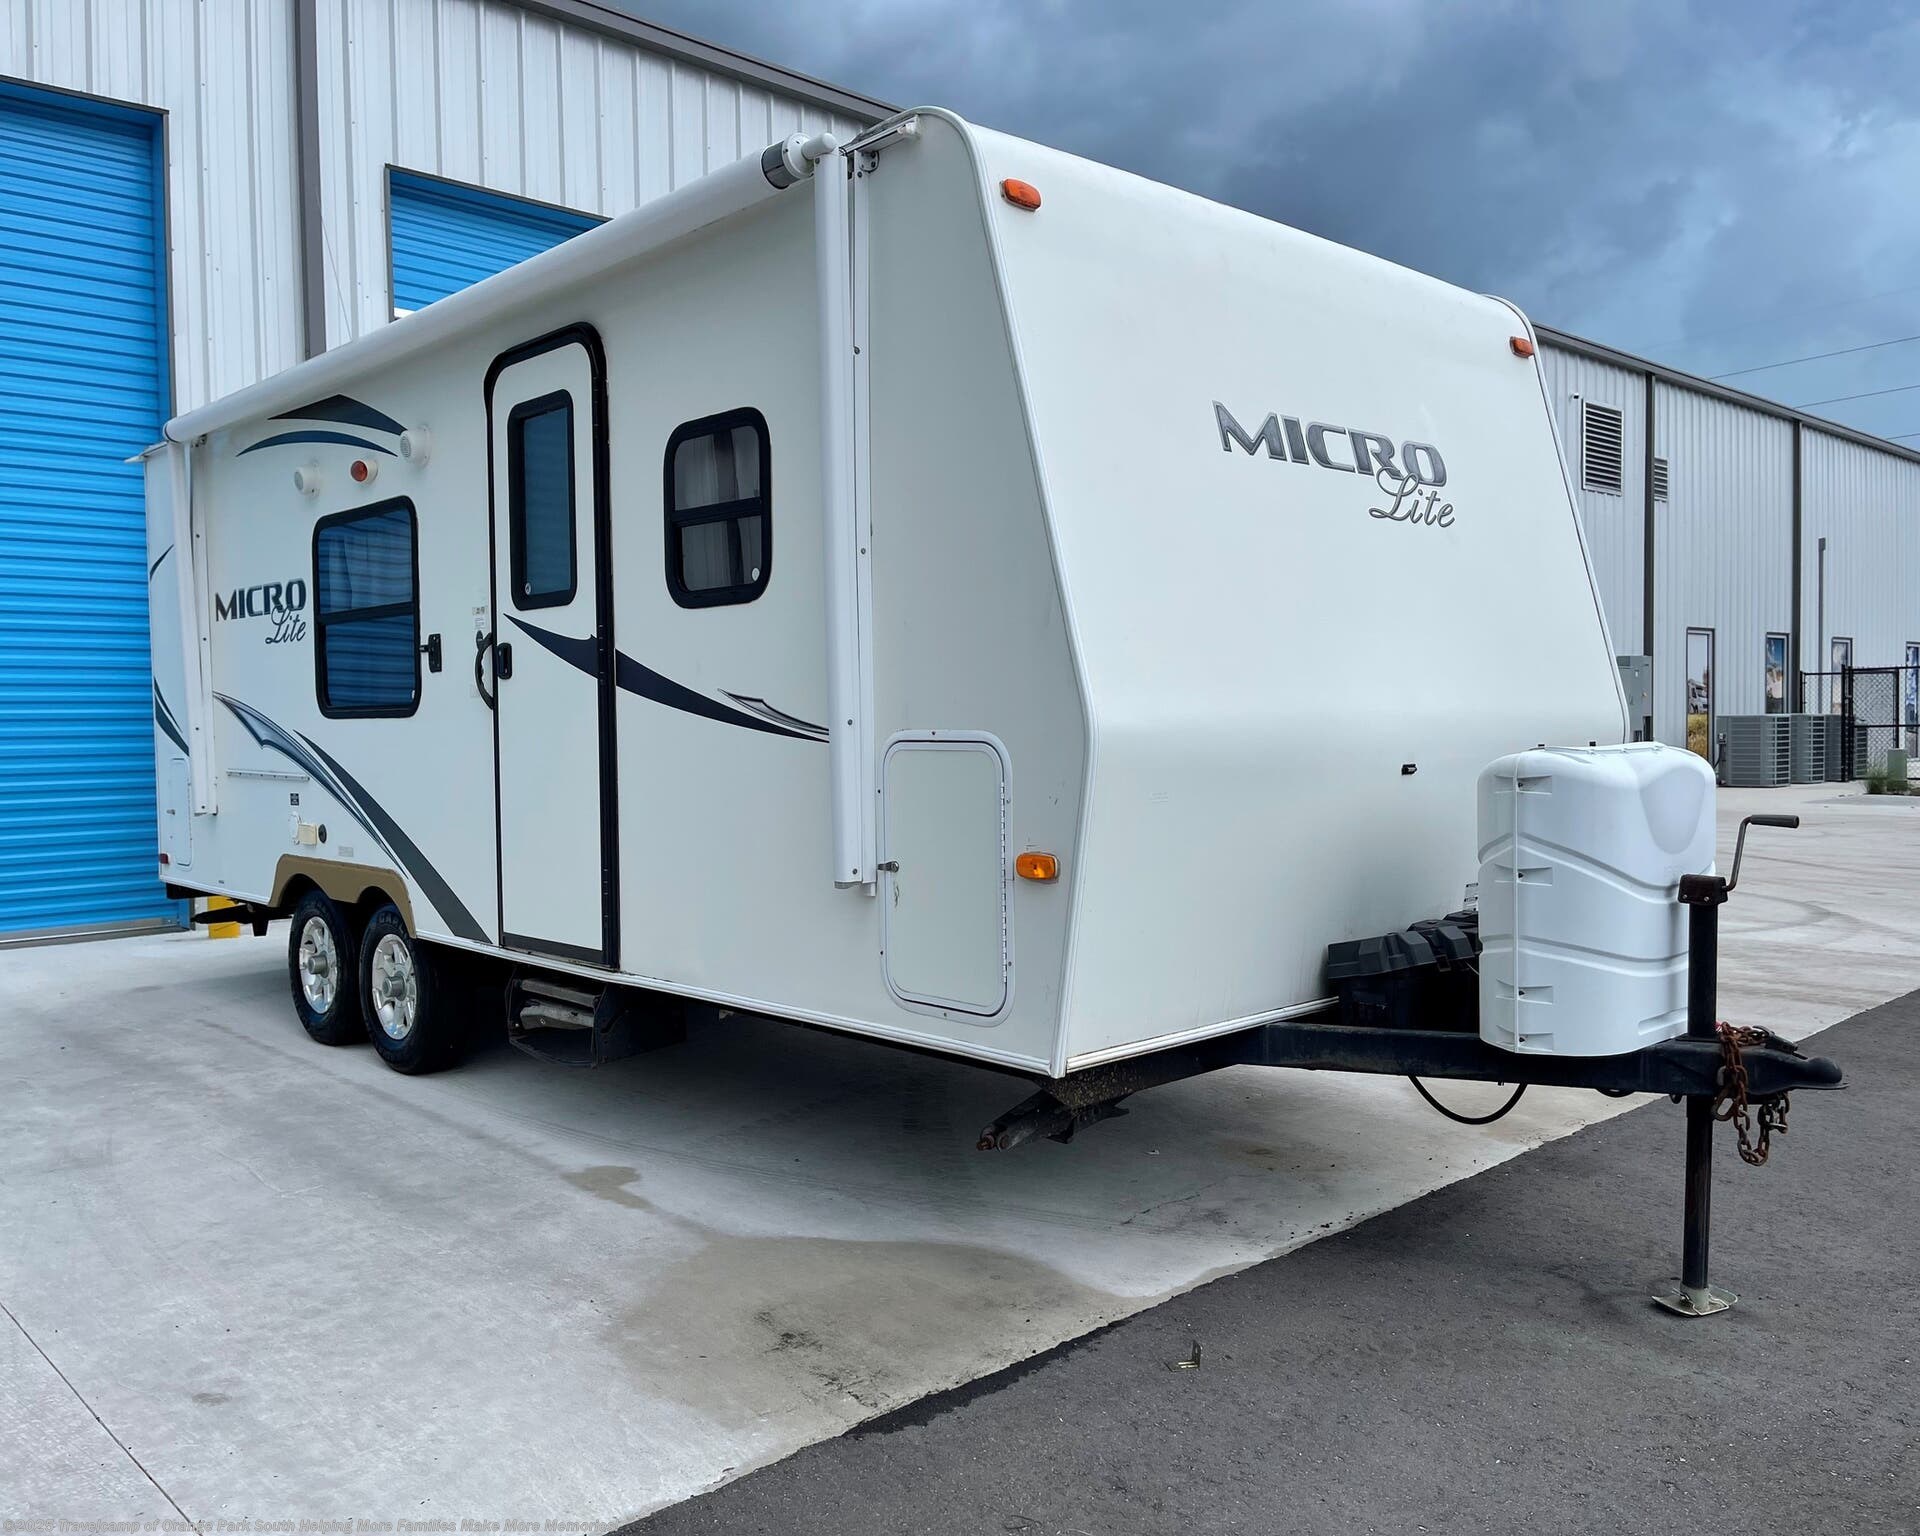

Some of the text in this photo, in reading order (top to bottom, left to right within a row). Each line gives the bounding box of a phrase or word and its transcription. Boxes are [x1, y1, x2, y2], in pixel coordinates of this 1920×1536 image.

[1212, 400, 1448, 487] MICRO
[1368, 466, 1456, 528] Lite
[215, 578, 307, 622] MICRO
[264, 606, 307, 645] Lite
